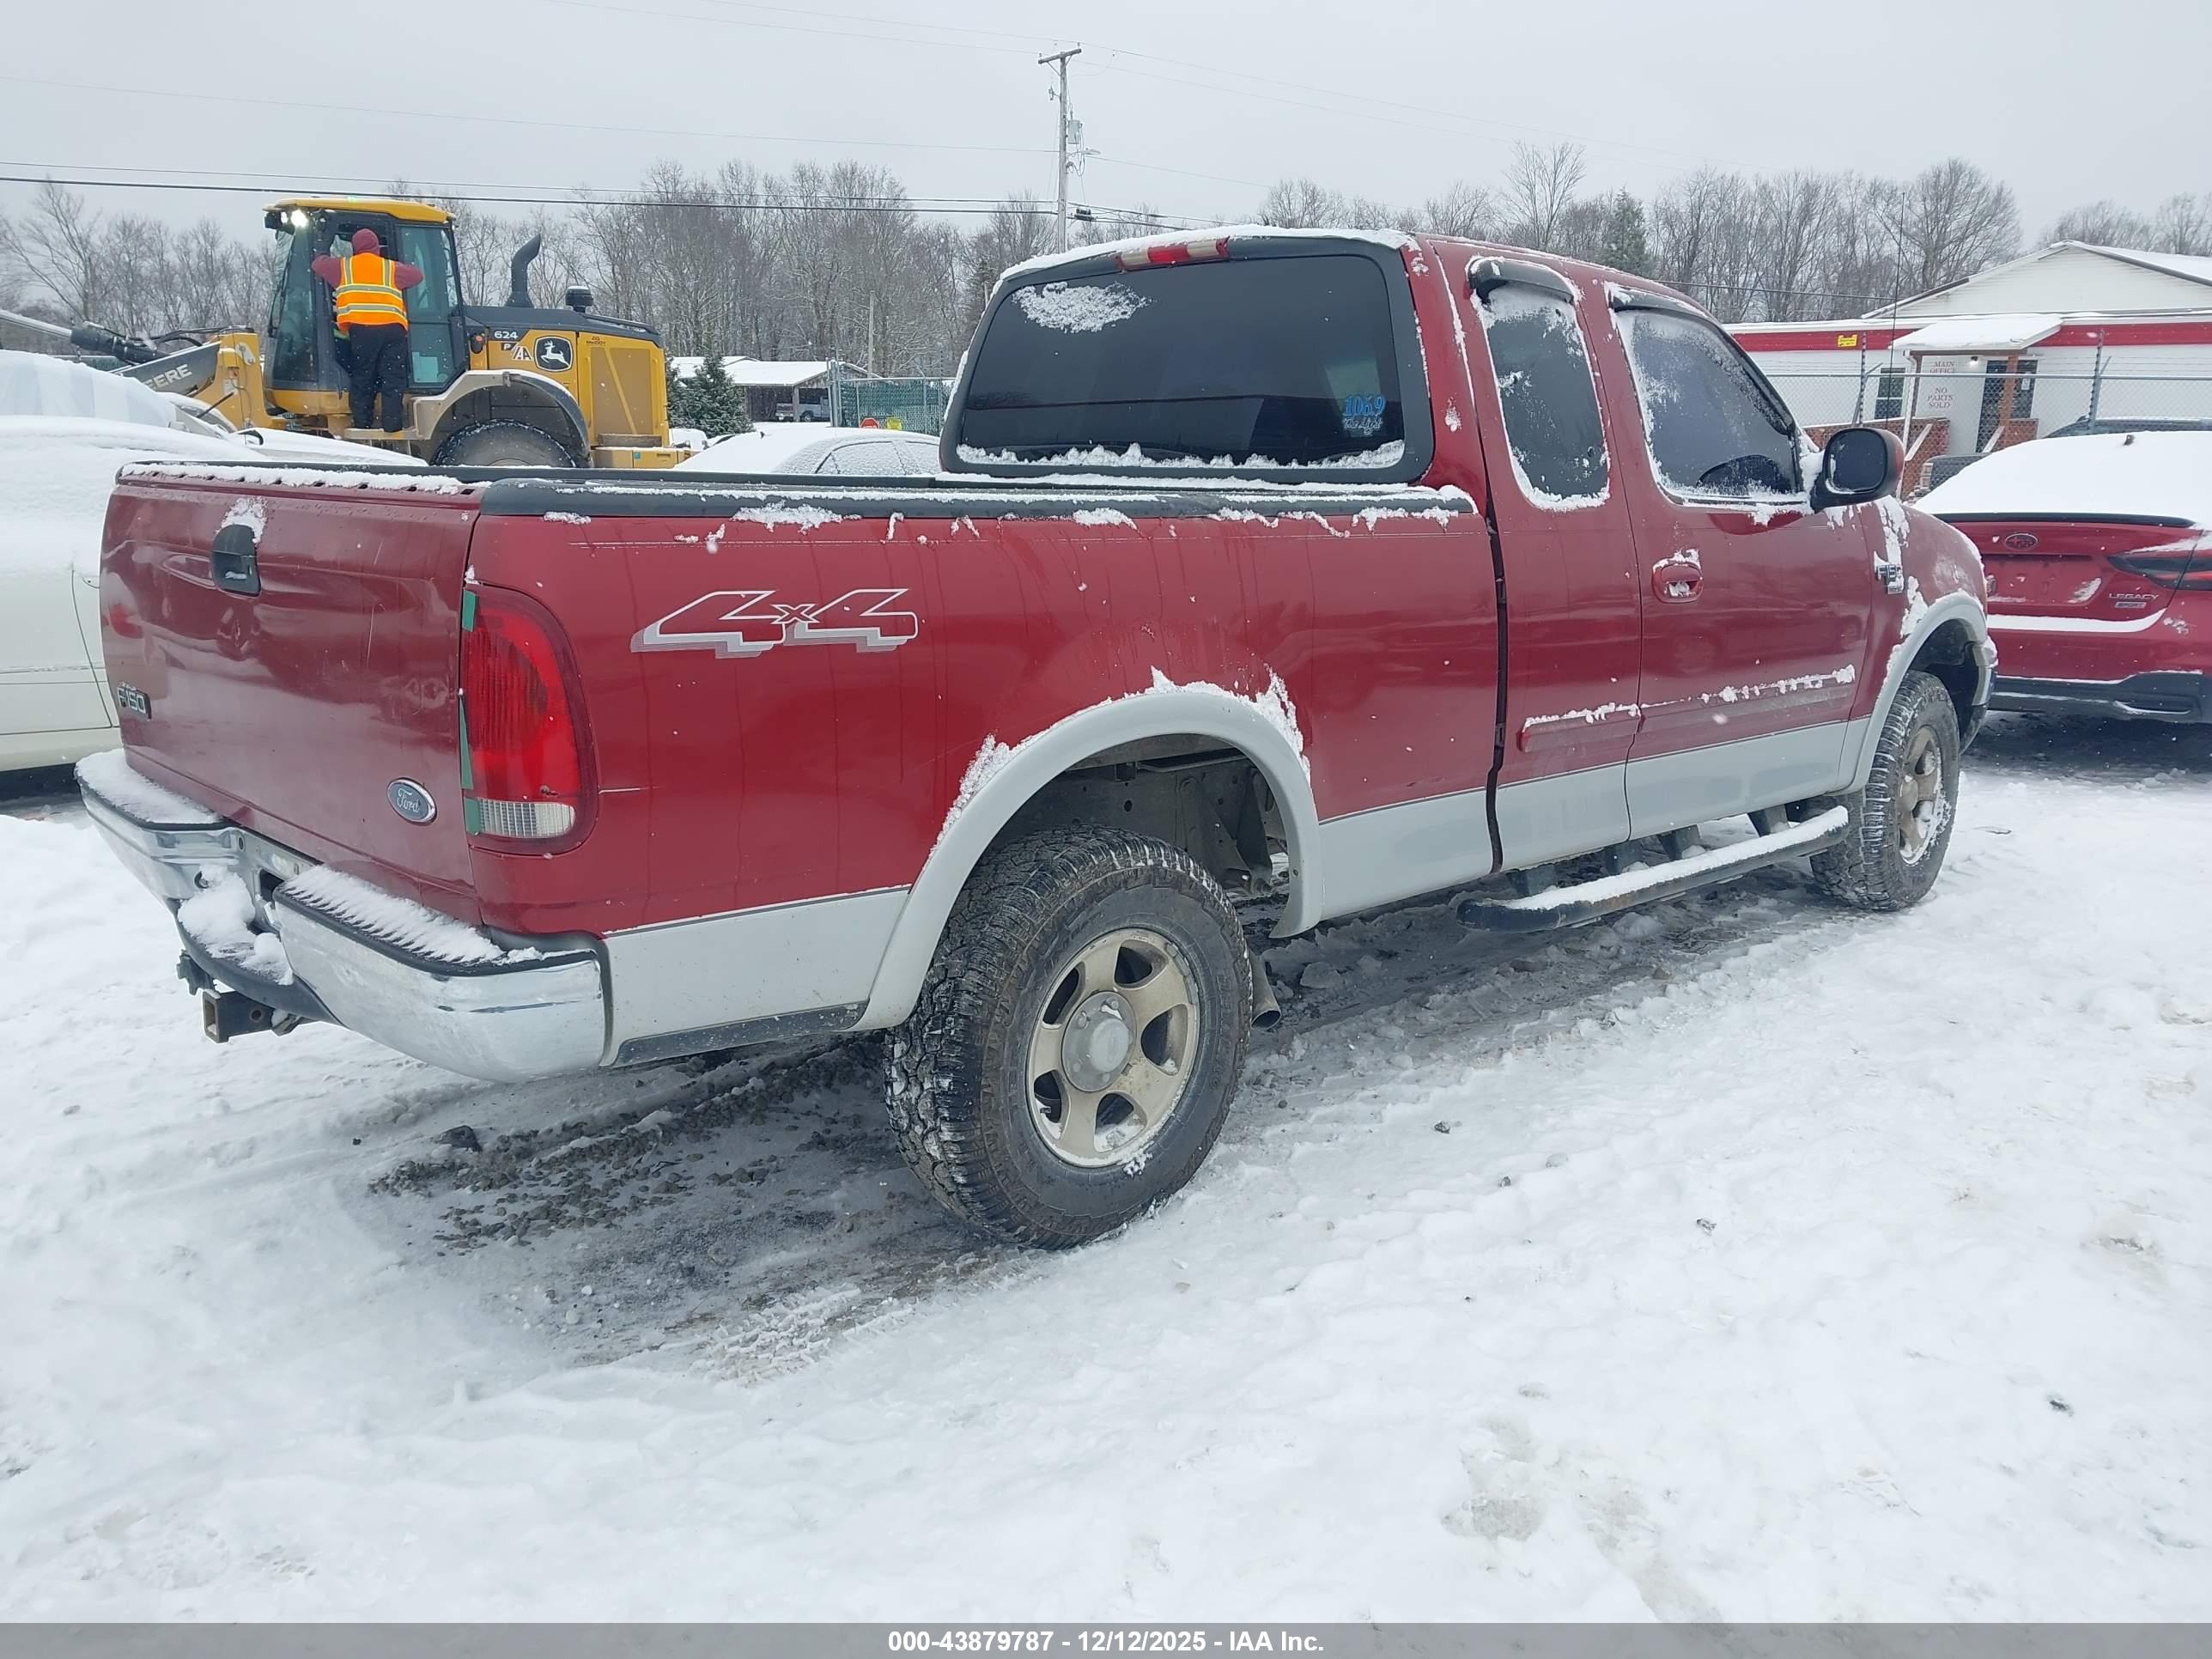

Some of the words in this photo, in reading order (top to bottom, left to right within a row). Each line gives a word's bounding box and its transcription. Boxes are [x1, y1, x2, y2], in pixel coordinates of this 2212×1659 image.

[494, 331, 519, 339] 624
[142, 363, 193, 389] EERE
[397, 787, 420, 813] Ford
